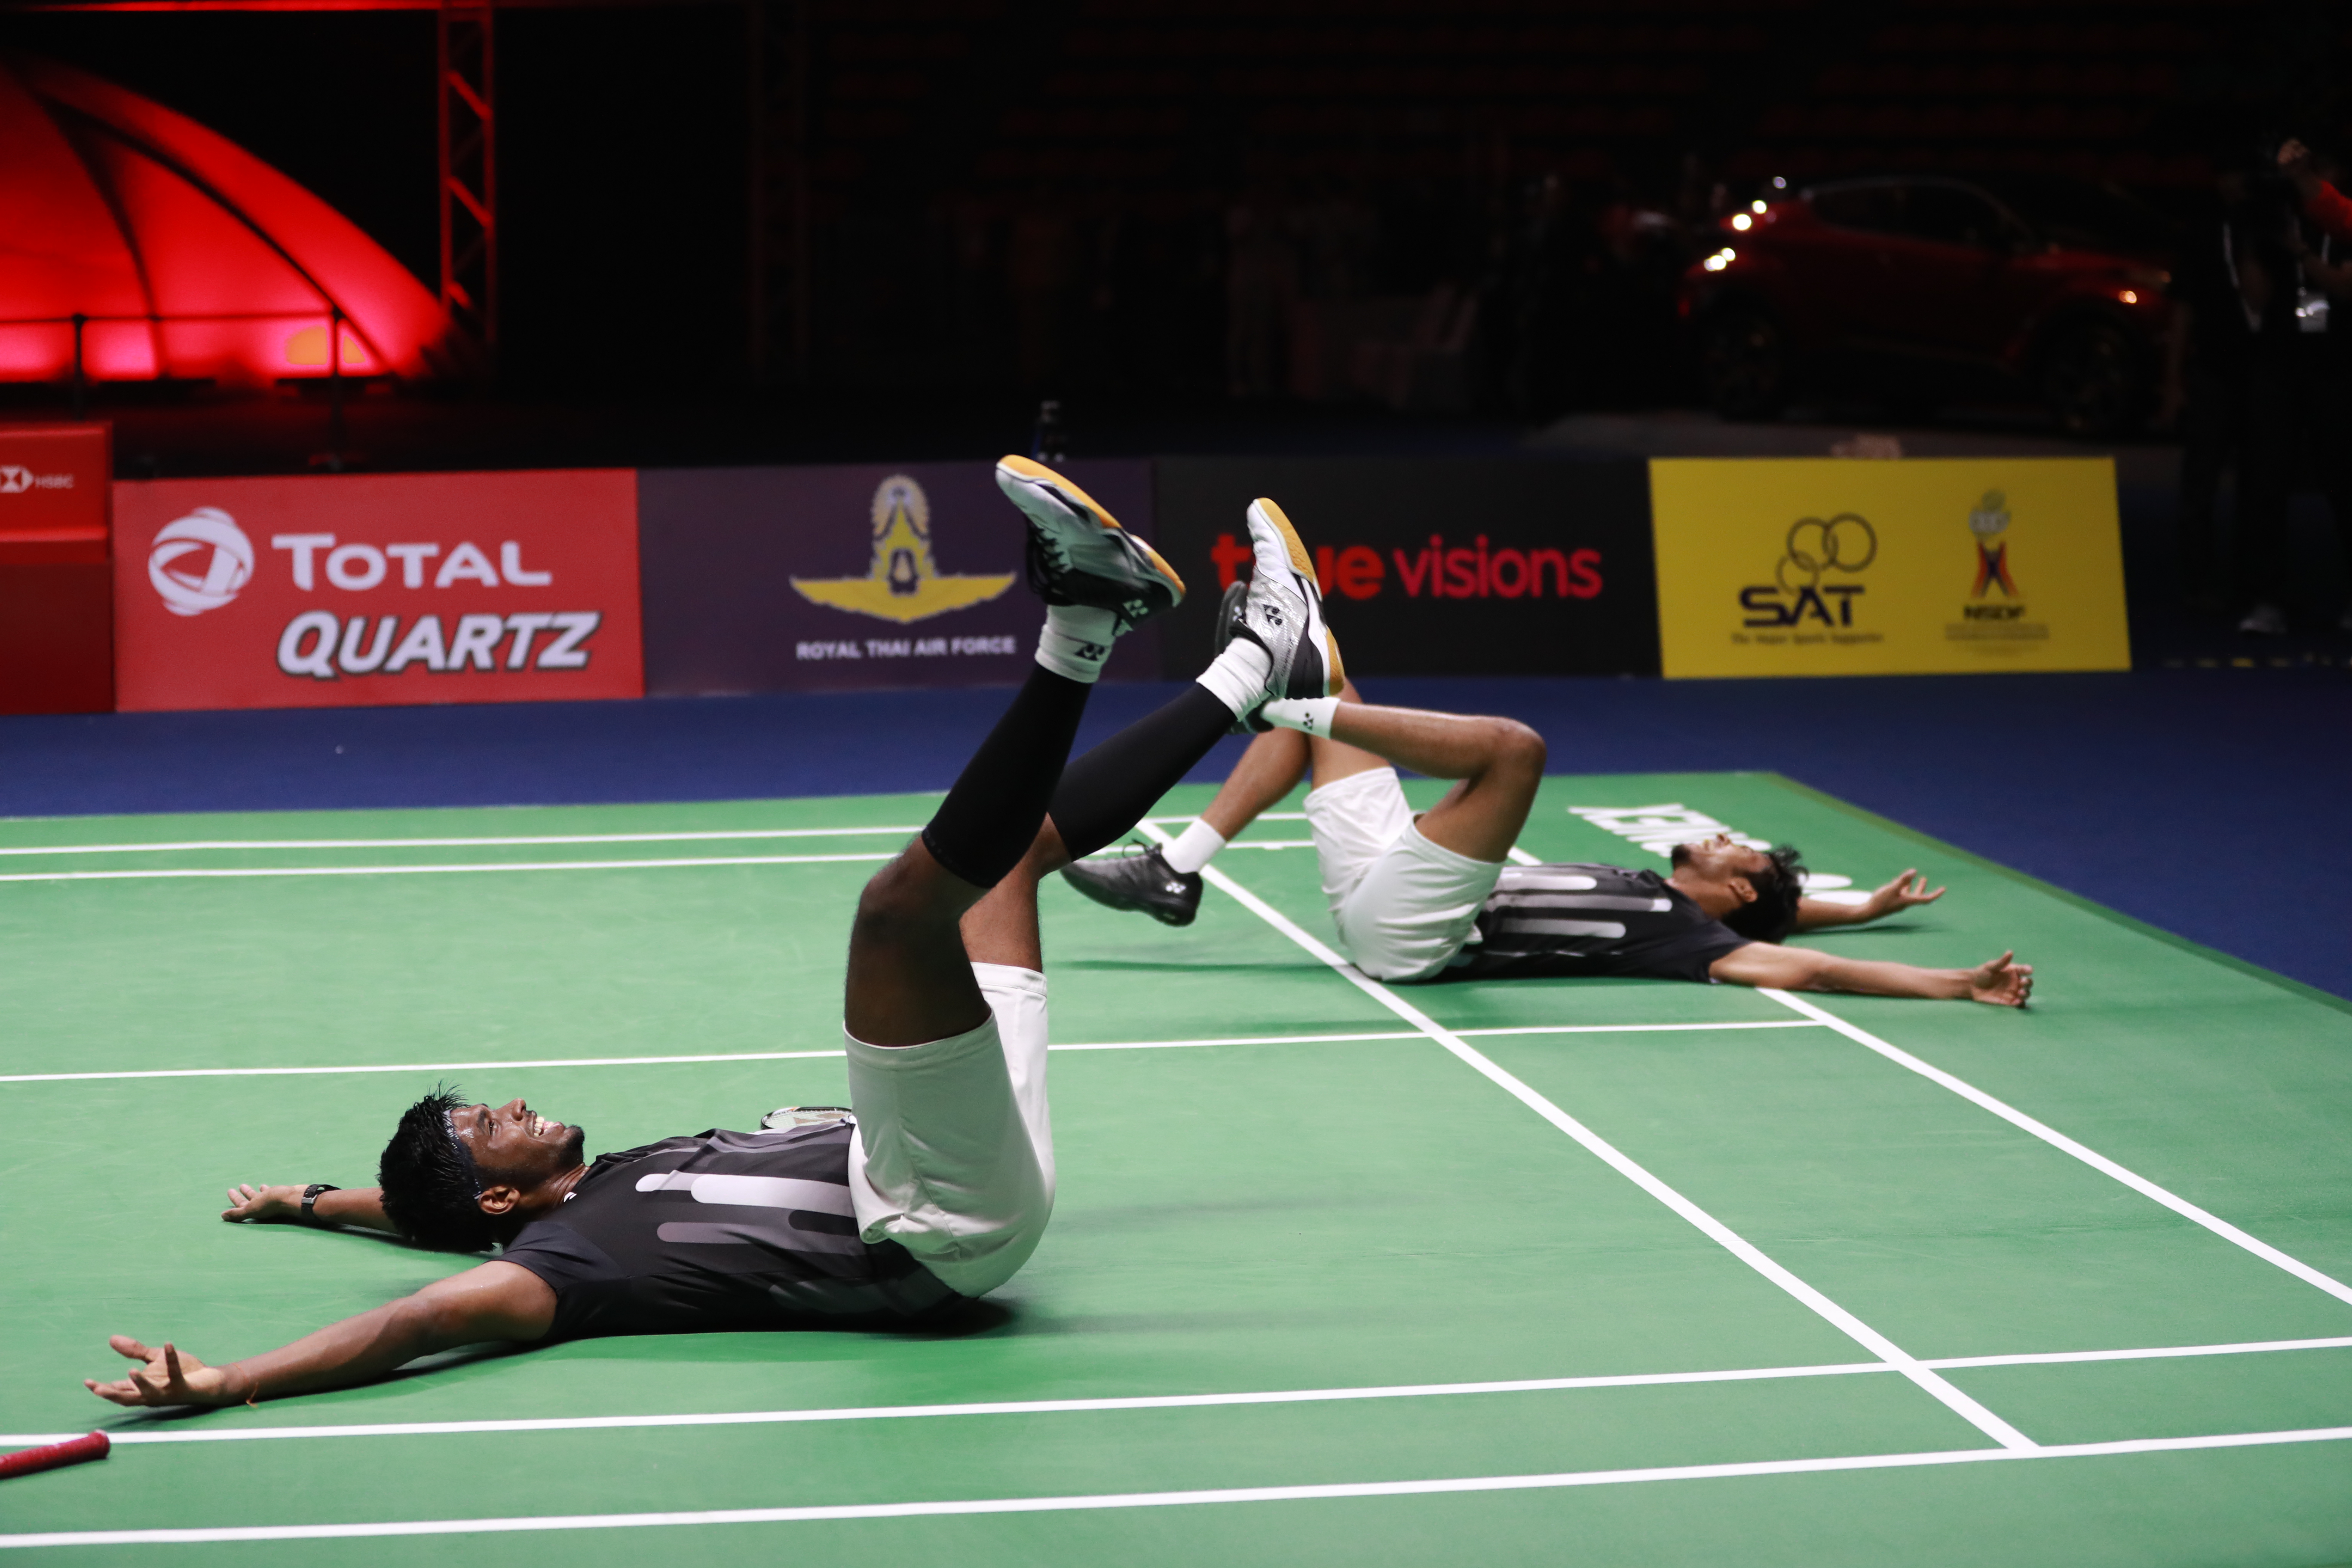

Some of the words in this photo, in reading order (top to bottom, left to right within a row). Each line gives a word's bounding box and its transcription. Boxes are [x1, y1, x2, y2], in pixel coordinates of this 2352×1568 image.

[35, 475, 74, 489] HSBC
[272, 533, 552, 591] TOTAL
[1393, 534, 1602, 598] visions
[1740, 585, 1864, 627] SAT
[278, 610, 600, 679] QUARTZ
[796, 641, 861, 659] ROYAL
[866, 639, 911, 656] THAI
[914, 637, 947, 655] AIR
[951, 636, 1015, 655] FORCE
